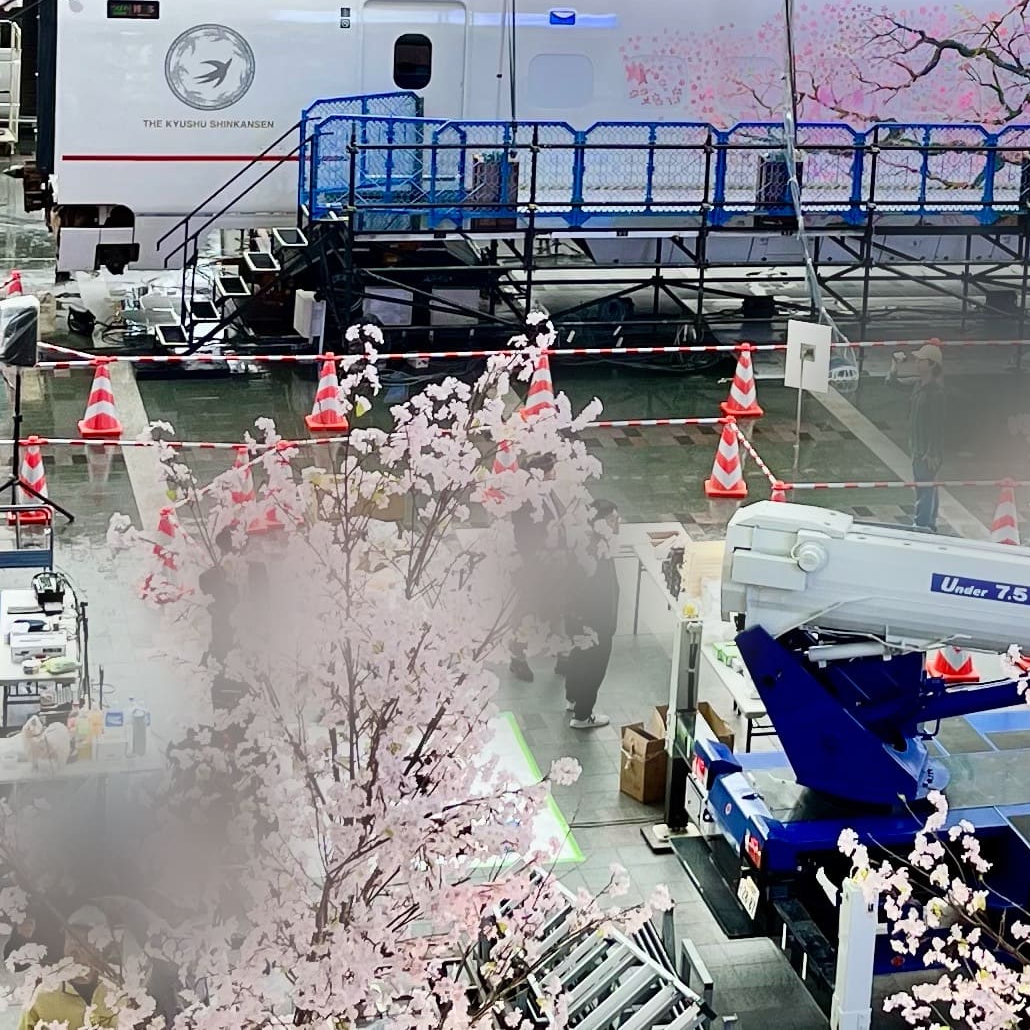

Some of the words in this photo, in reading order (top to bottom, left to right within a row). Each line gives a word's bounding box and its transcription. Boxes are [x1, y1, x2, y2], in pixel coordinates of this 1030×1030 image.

[143, 119, 163, 128] THE
[165, 119, 207, 128] KYUSHU
[209, 120, 274, 129] SHINKANSEN
[941, 576, 988, 597] Under
[995, 584, 1028, 602] 7.5
